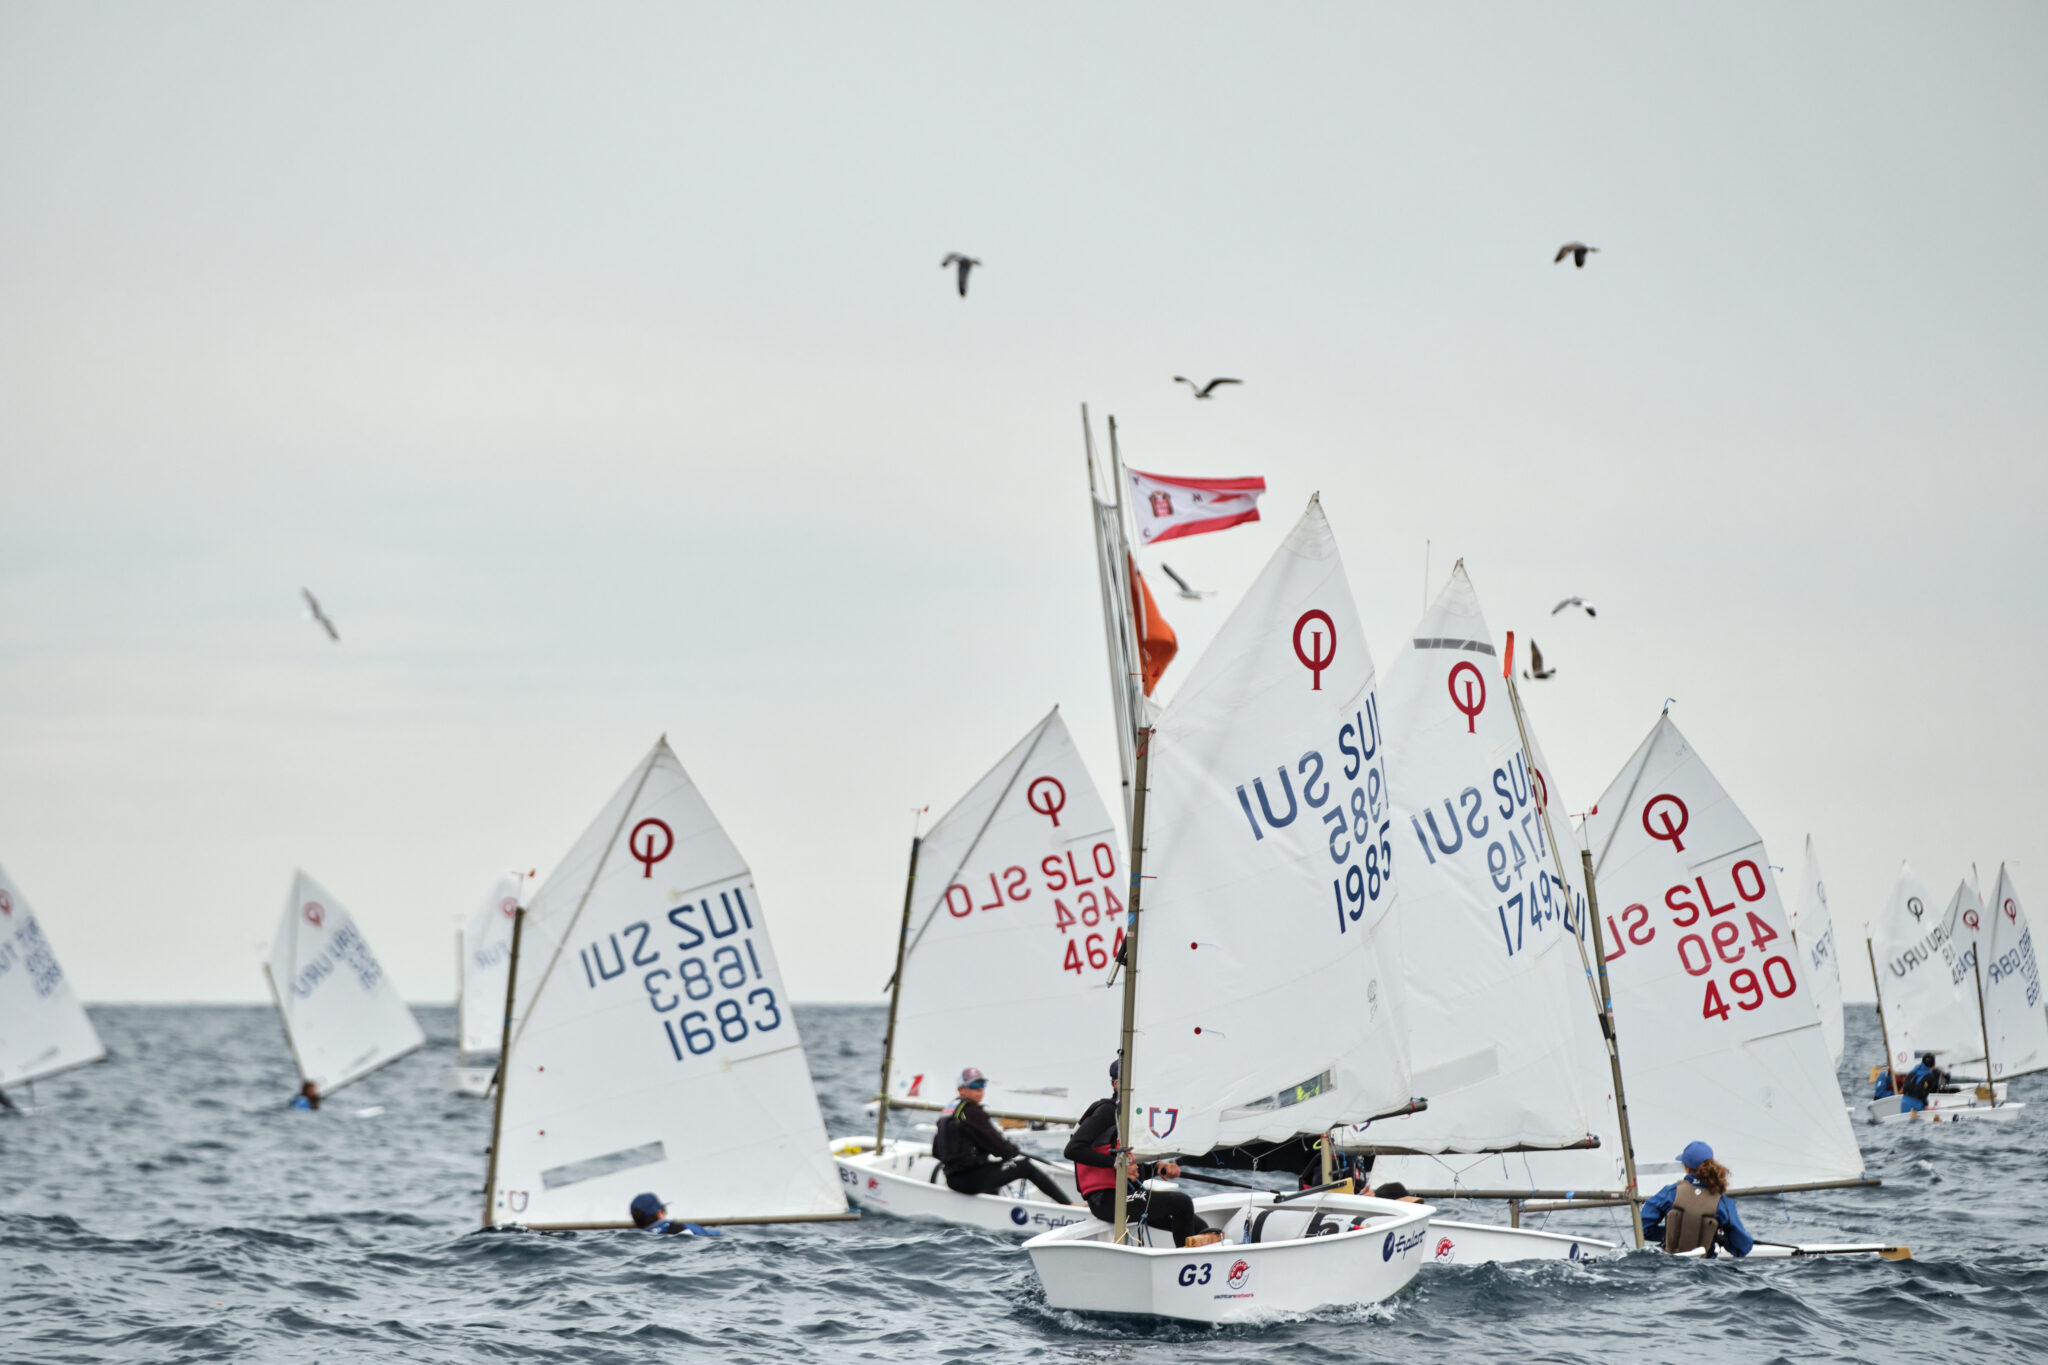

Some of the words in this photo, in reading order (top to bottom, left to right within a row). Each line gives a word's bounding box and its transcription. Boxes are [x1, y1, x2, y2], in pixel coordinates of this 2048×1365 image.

[1338, 691, 1382, 780] SUI
[1493, 747, 1534, 820] SUI
[1041, 842, 1115, 891] SLO
[1333, 819, 1391, 934] 1985
[1665, 860, 1766, 927] SLO
[668, 887, 754, 951] SUI
[1498, 869, 1552, 957] 1749
[1702, 955, 1796, 1021] 490
[664, 987, 781, 1062] 1683
[1178, 1262, 1212, 1287] G3
